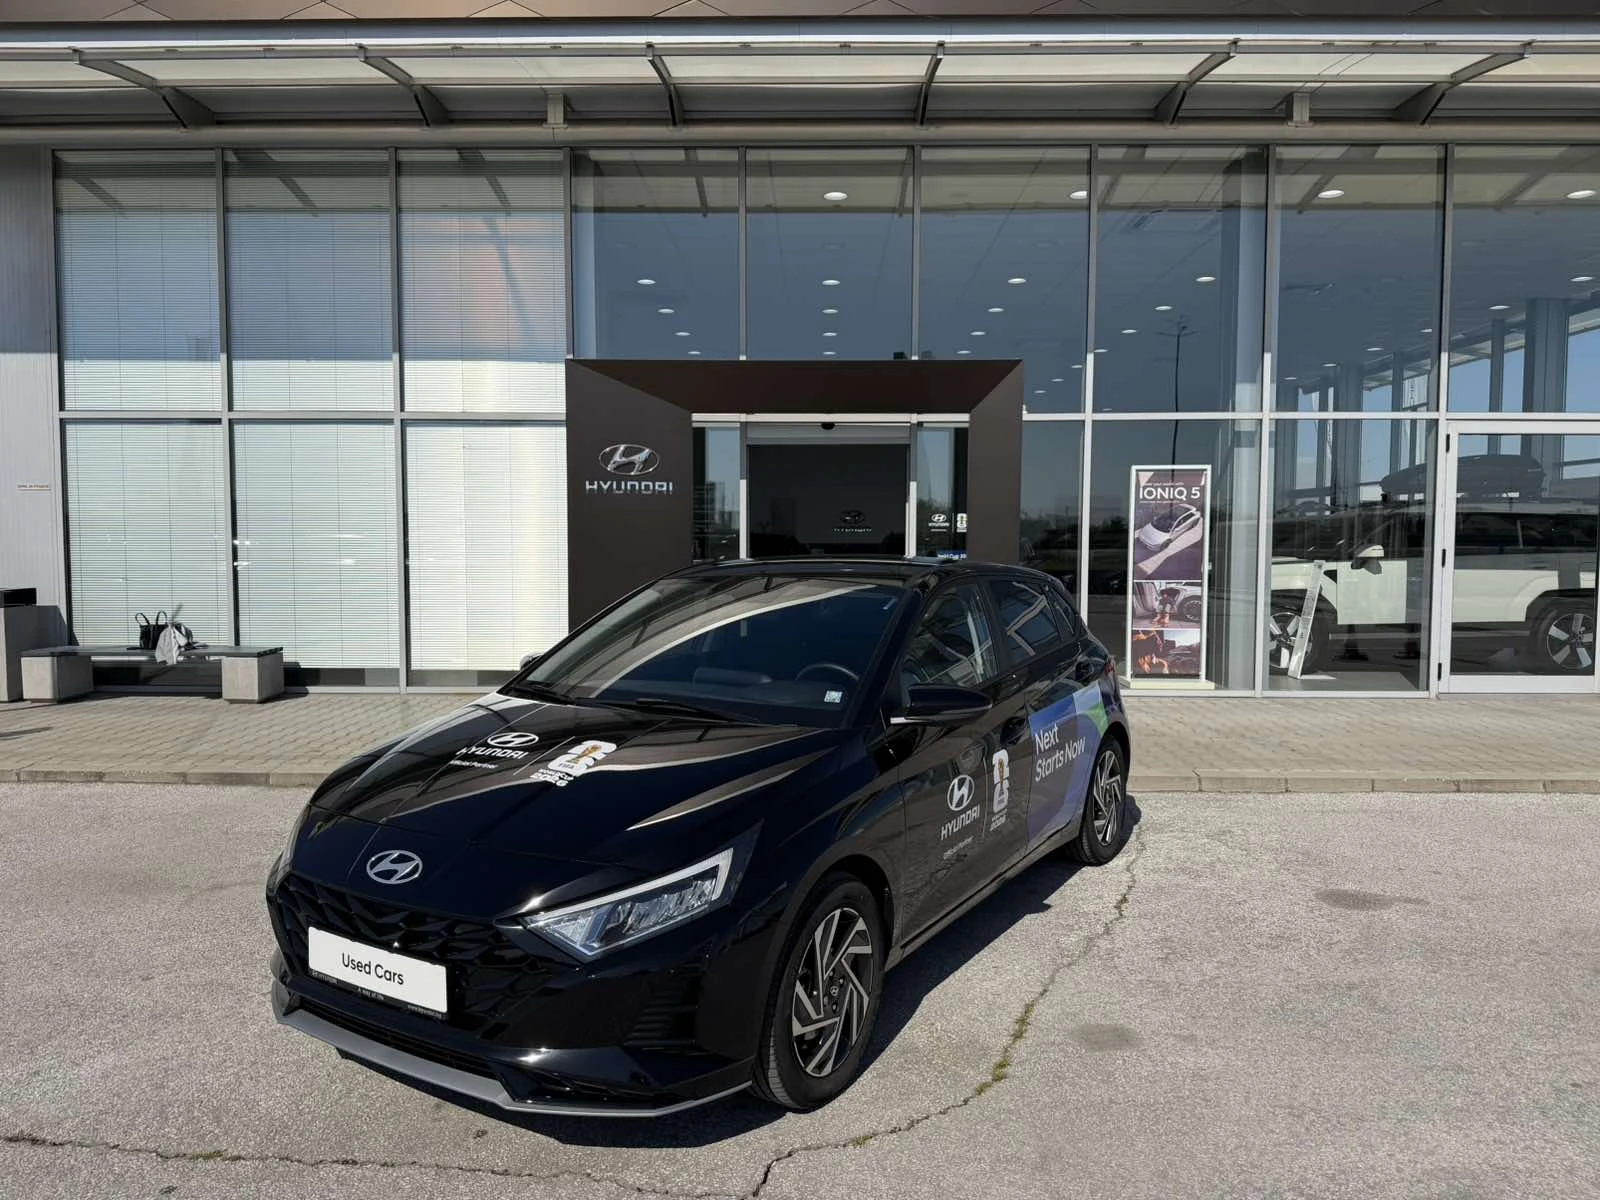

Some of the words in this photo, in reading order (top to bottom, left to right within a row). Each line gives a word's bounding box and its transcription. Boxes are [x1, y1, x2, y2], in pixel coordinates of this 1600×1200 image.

[585, 480, 673, 495] HYUNDAI
[1139, 487, 1187, 501] IONIQ
[1190, 487, 1201, 499] 5
[455, 746, 529, 760] HYUNDAI
[1034, 722, 1059, 756] Next
[1035, 750, 1064, 782] Starts
[1064, 736, 1086, 763] Now
[940, 804, 981, 840] HYUNDAI
[342, 952, 372, 976] Used
[374, 964, 405, 986] Cars
